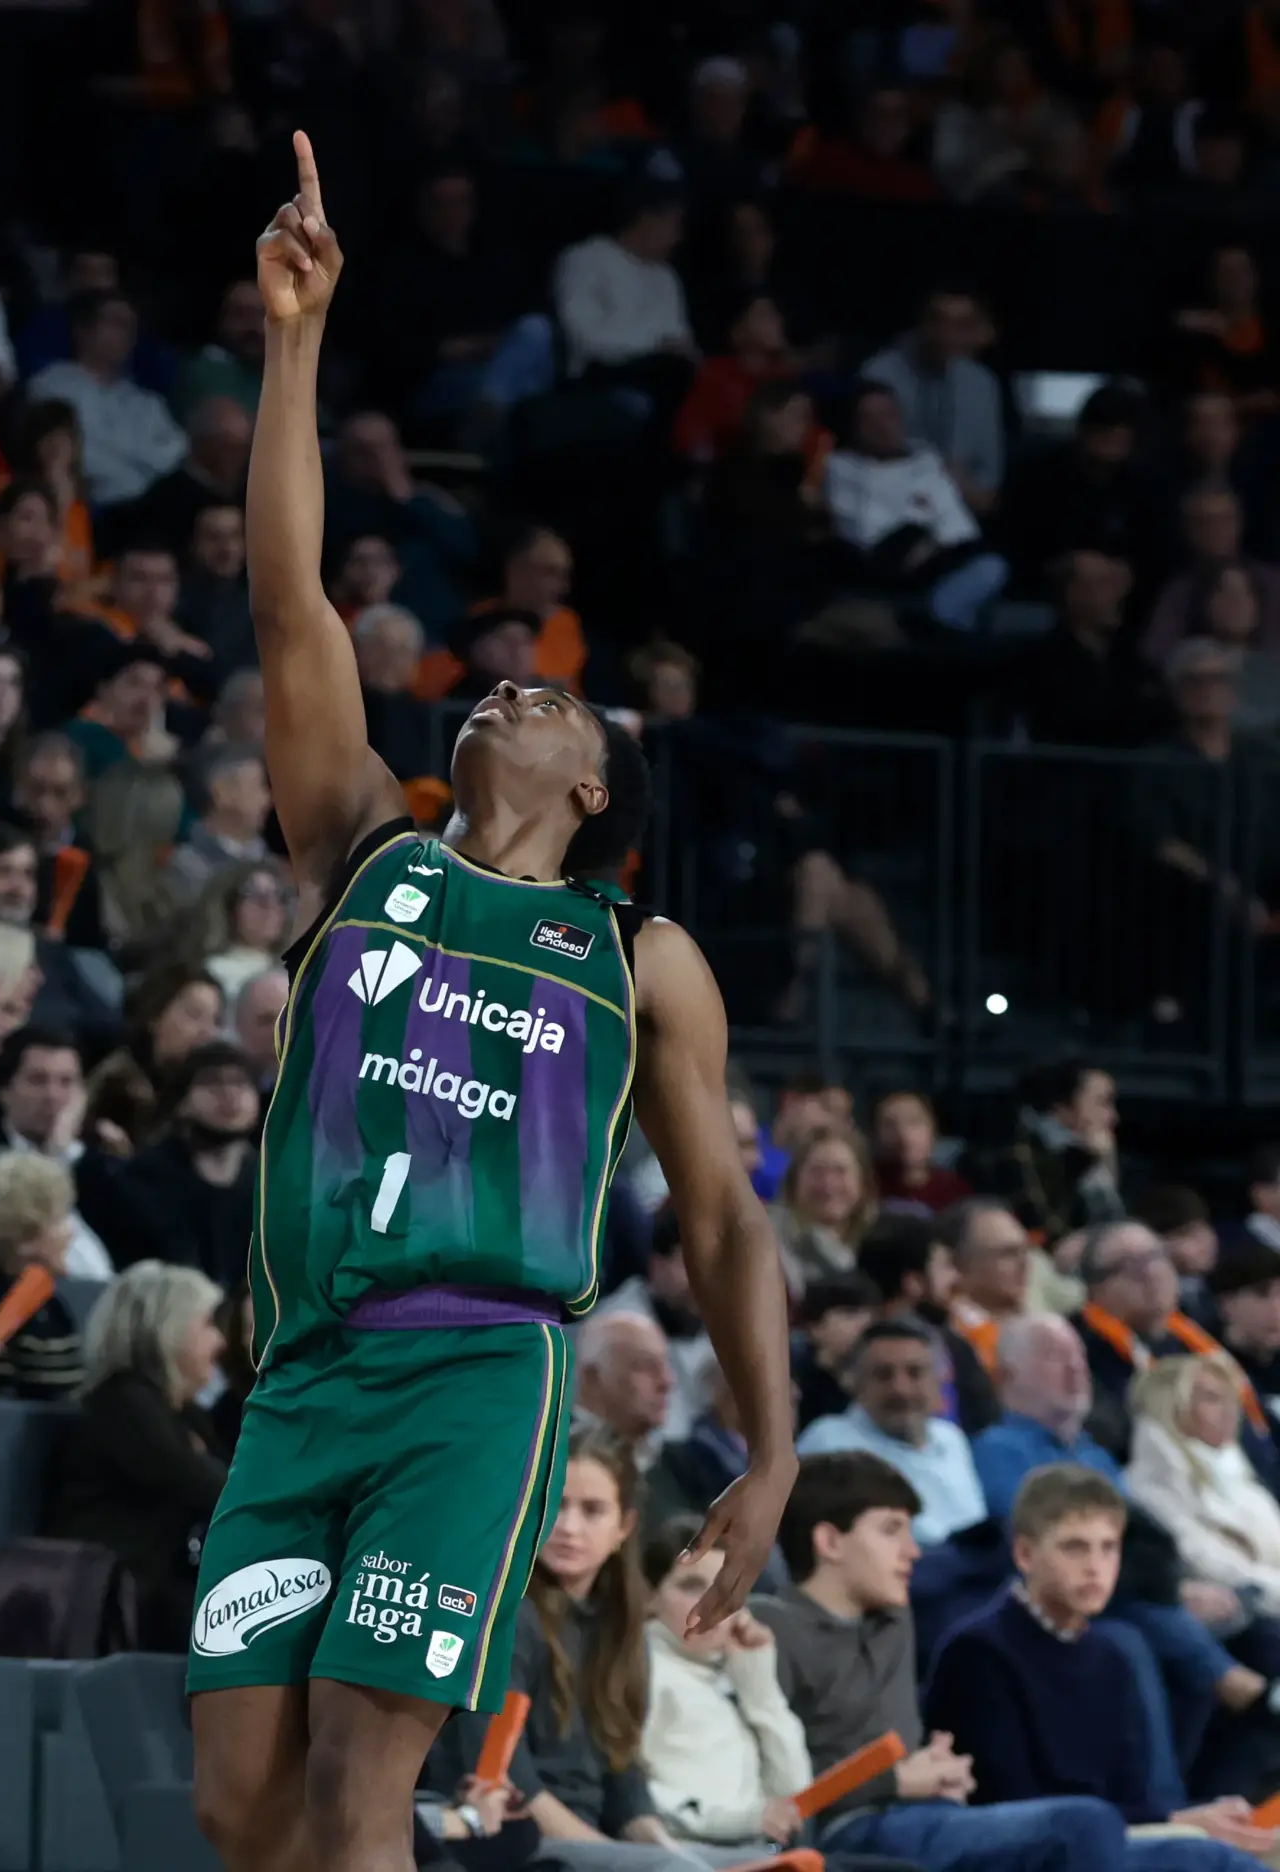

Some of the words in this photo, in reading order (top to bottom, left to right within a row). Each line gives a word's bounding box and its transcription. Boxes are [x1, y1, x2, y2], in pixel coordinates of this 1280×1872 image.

[537, 935, 585, 955] endesa
[540, 926, 563, 938] liga
[419, 977, 565, 1054] Unicaja
[370, 1151, 412, 1234] 1
[361, 1550, 412, 1575] sabor
[356, 1572, 365, 1585] a
[360, 1572, 430, 1610] má
[200, 1567, 325, 1646] famadesa
[345, 1590, 423, 1643] laga
[442, 1596, 467, 1610] acb
